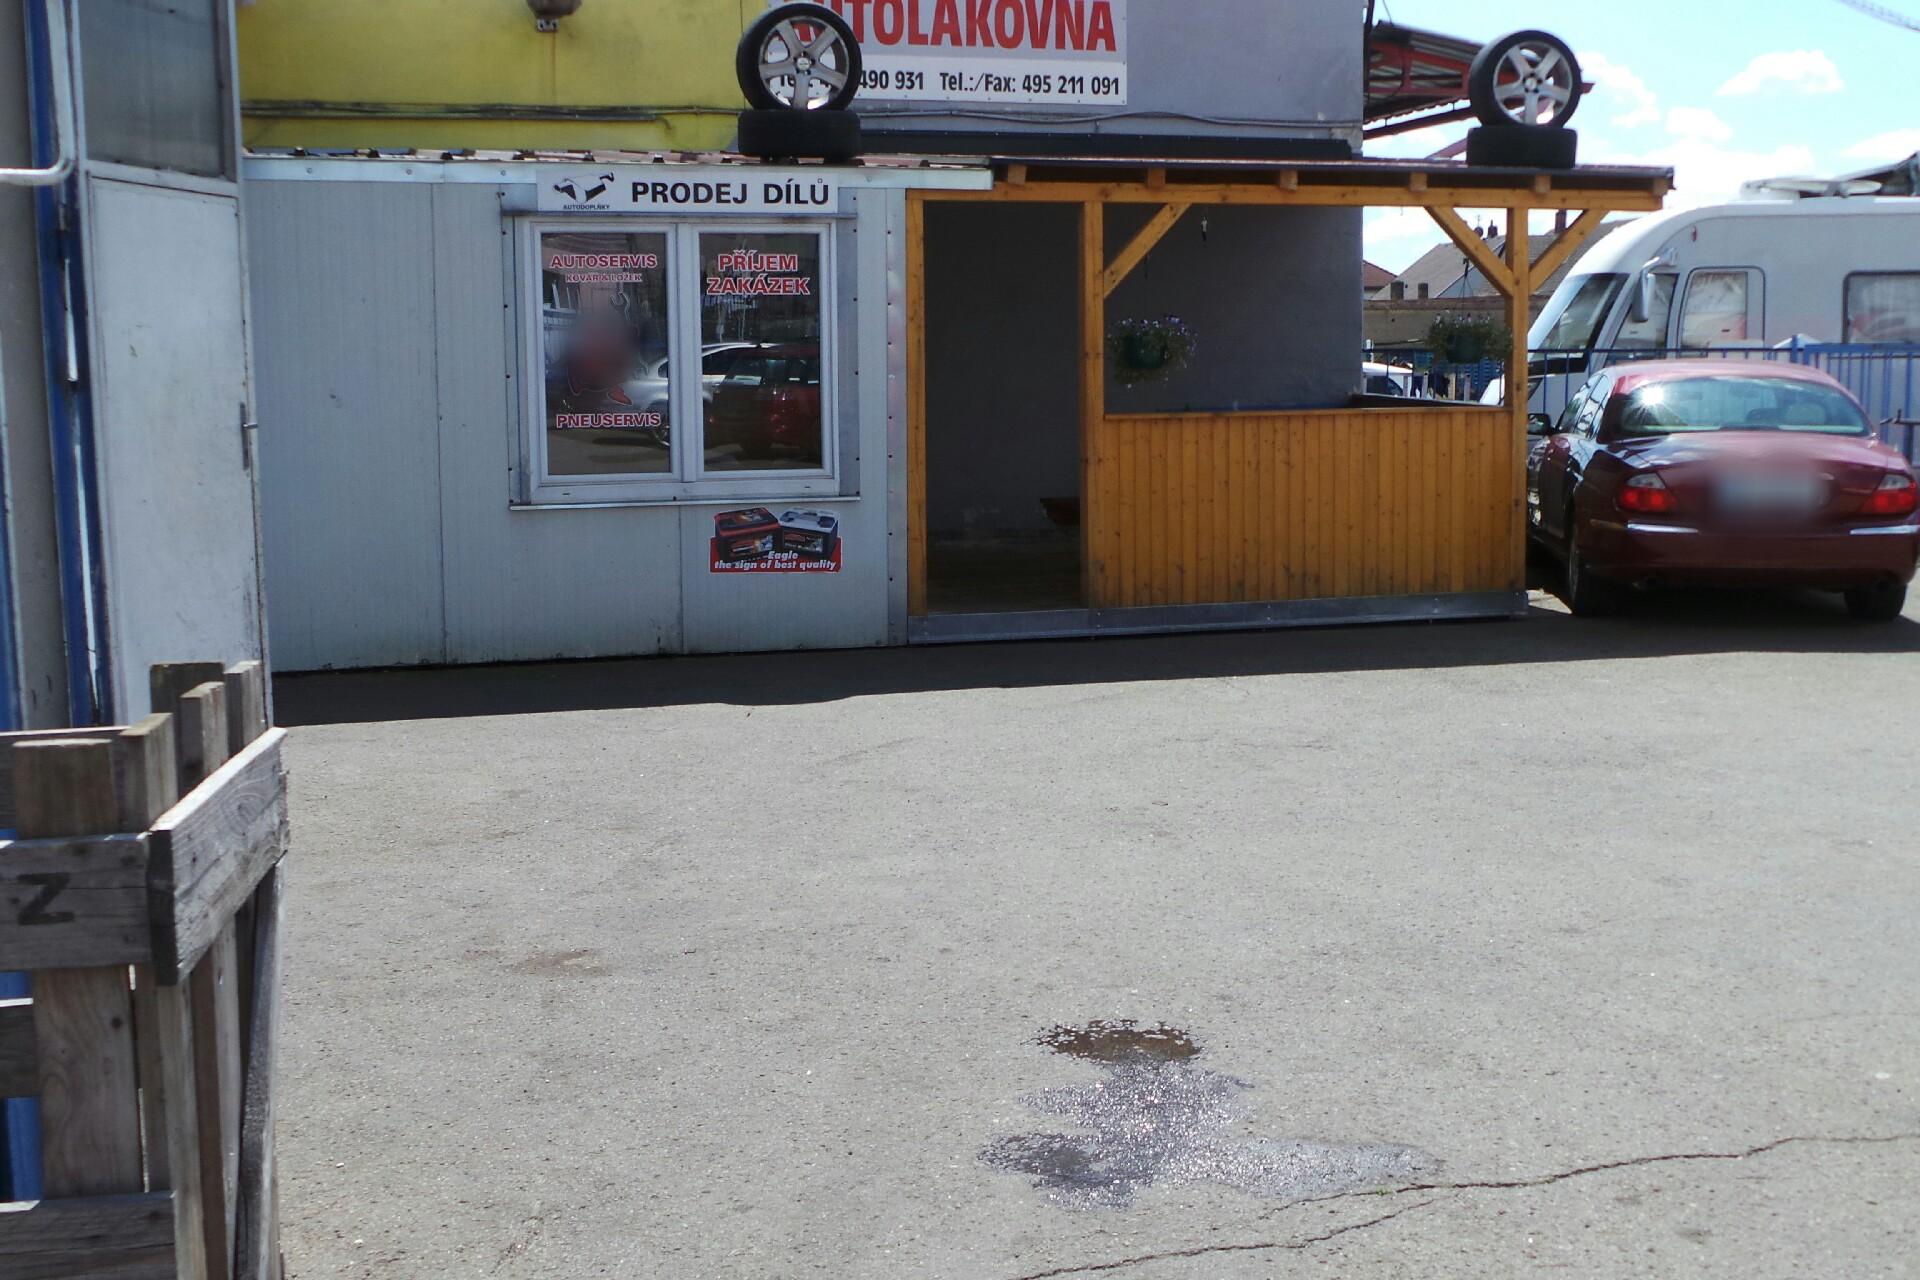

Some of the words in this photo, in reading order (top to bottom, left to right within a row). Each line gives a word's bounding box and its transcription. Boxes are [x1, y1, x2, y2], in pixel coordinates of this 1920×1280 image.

[767, 0, 1117, 52] TOLAKOVNA
[859, 70, 890, 89] 490
[895, 71, 924, 90] 931
[939, 72, 1016, 92] Tel.:/Fax:
[1022, 74, 1052, 94] 495
[1057, 76, 1084, 95] 211
[1091, 77, 1119, 96] 091
[631, 182, 747, 204] PRODEJ
[763, 178, 829, 205] DÍLŮ
[550, 254, 658, 268] AUTOSERVIS
[718, 249, 798, 271] PŘÍJEM
[707, 273, 811, 295] ZAKÁZEK
[556, 412, 661, 428] PNEUSERVIS
[714, 560, 732, 569] the
[735, 560, 758, 571] sign
[760, 560, 772, 569] of
[774, 560, 797, 569] best
[800, 560, 837, 570] quality
[768, 550, 799, 561] Eagle
